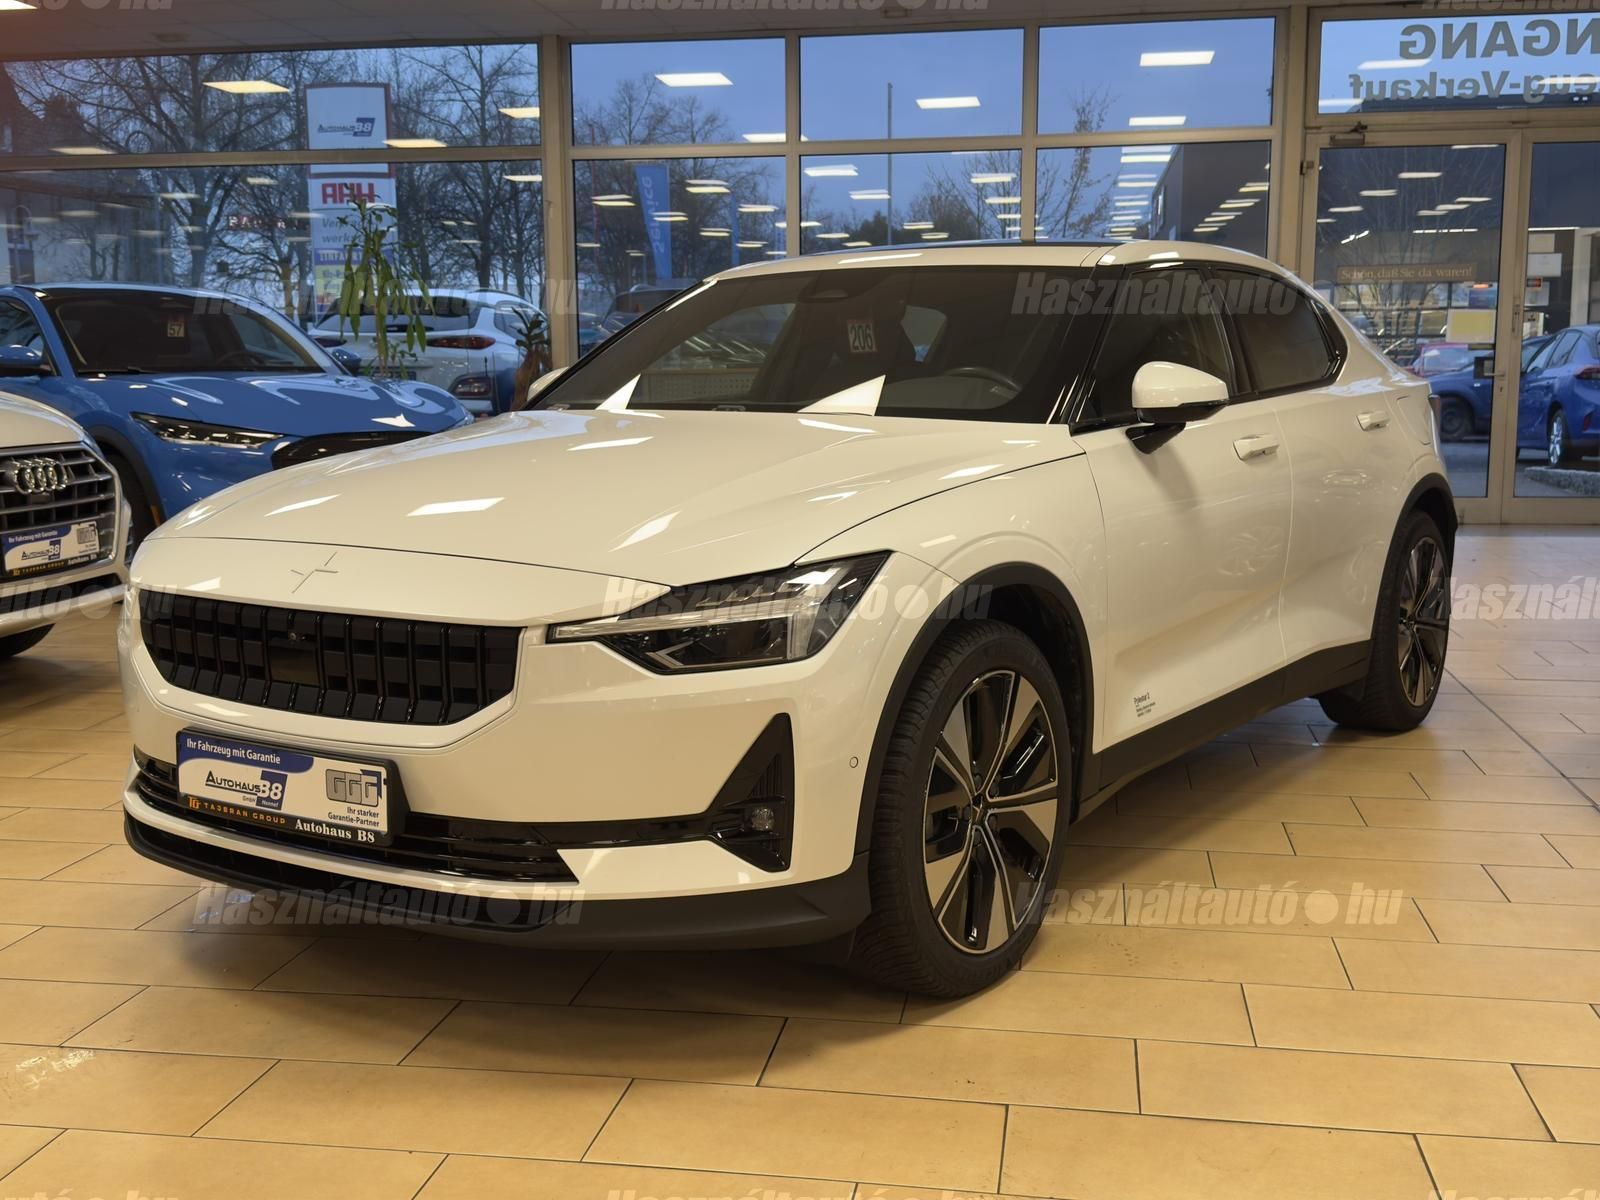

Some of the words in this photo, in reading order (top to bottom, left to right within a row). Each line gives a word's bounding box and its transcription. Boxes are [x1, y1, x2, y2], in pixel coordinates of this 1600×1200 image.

[850, 324, 873, 350] 206
[186, 738, 197, 749] Ihr
[197, 740, 231, 757] Fahrzeug
[232, 748, 246, 758] mit
[246, 749, 281, 764] Garantie
[252, 812, 286, 824] GROUP
[328, 812, 379, 827] Garantie-Partner
[347, 806, 356, 814] Ihr
[357, 808, 379, 818] starker
[295, 818, 352, 839] Autohaus
[357, 829, 375, 843] B8
